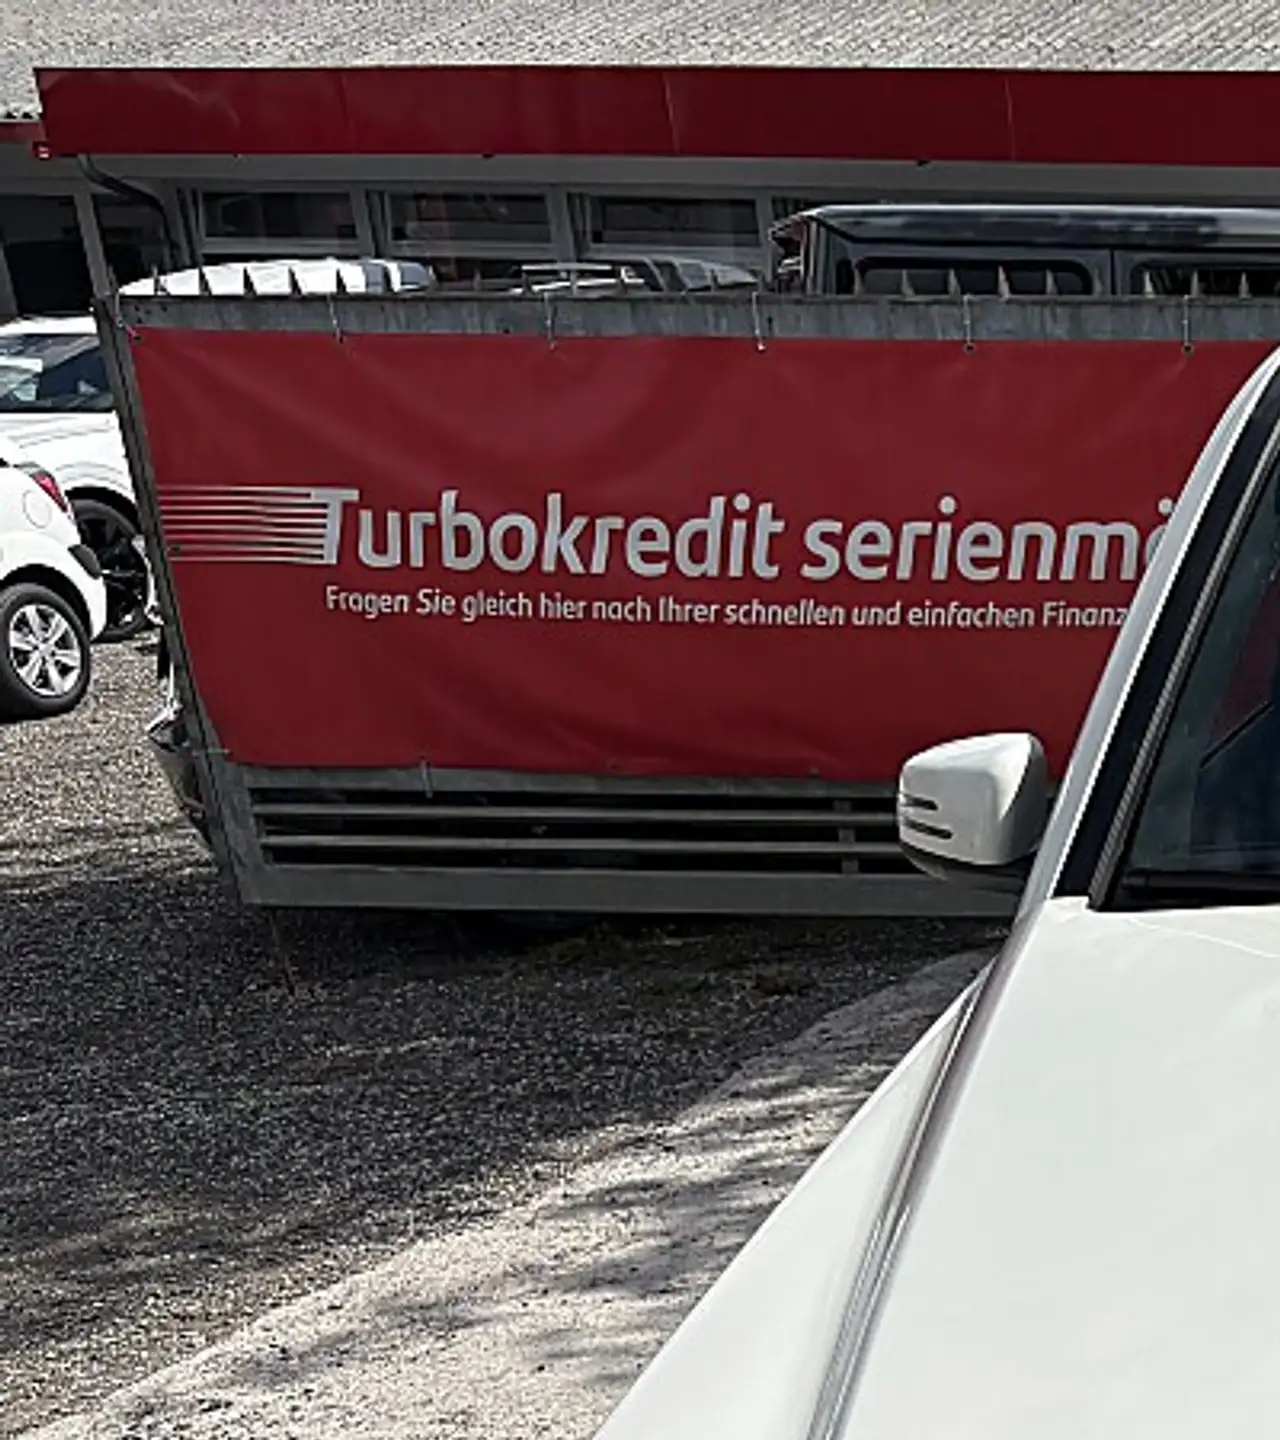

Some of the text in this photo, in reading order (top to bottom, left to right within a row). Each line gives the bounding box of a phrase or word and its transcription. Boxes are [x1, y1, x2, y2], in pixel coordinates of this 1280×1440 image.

[311, 486, 785, 579] Turbokredit
[325, 585, 408, 619] Fragen
[416, 589, 456, 614] Sie
[461, 591, 532, 621] gleich
[539, 592, 586, 618] hier
[592, 596, 651, 622] nach
[658, 598, 720, 623] Ihrer
[724, 599, 846, 626] schnellen
[851, 602, 900, 627] und
[907, 602, 1034, 628] einfachen
